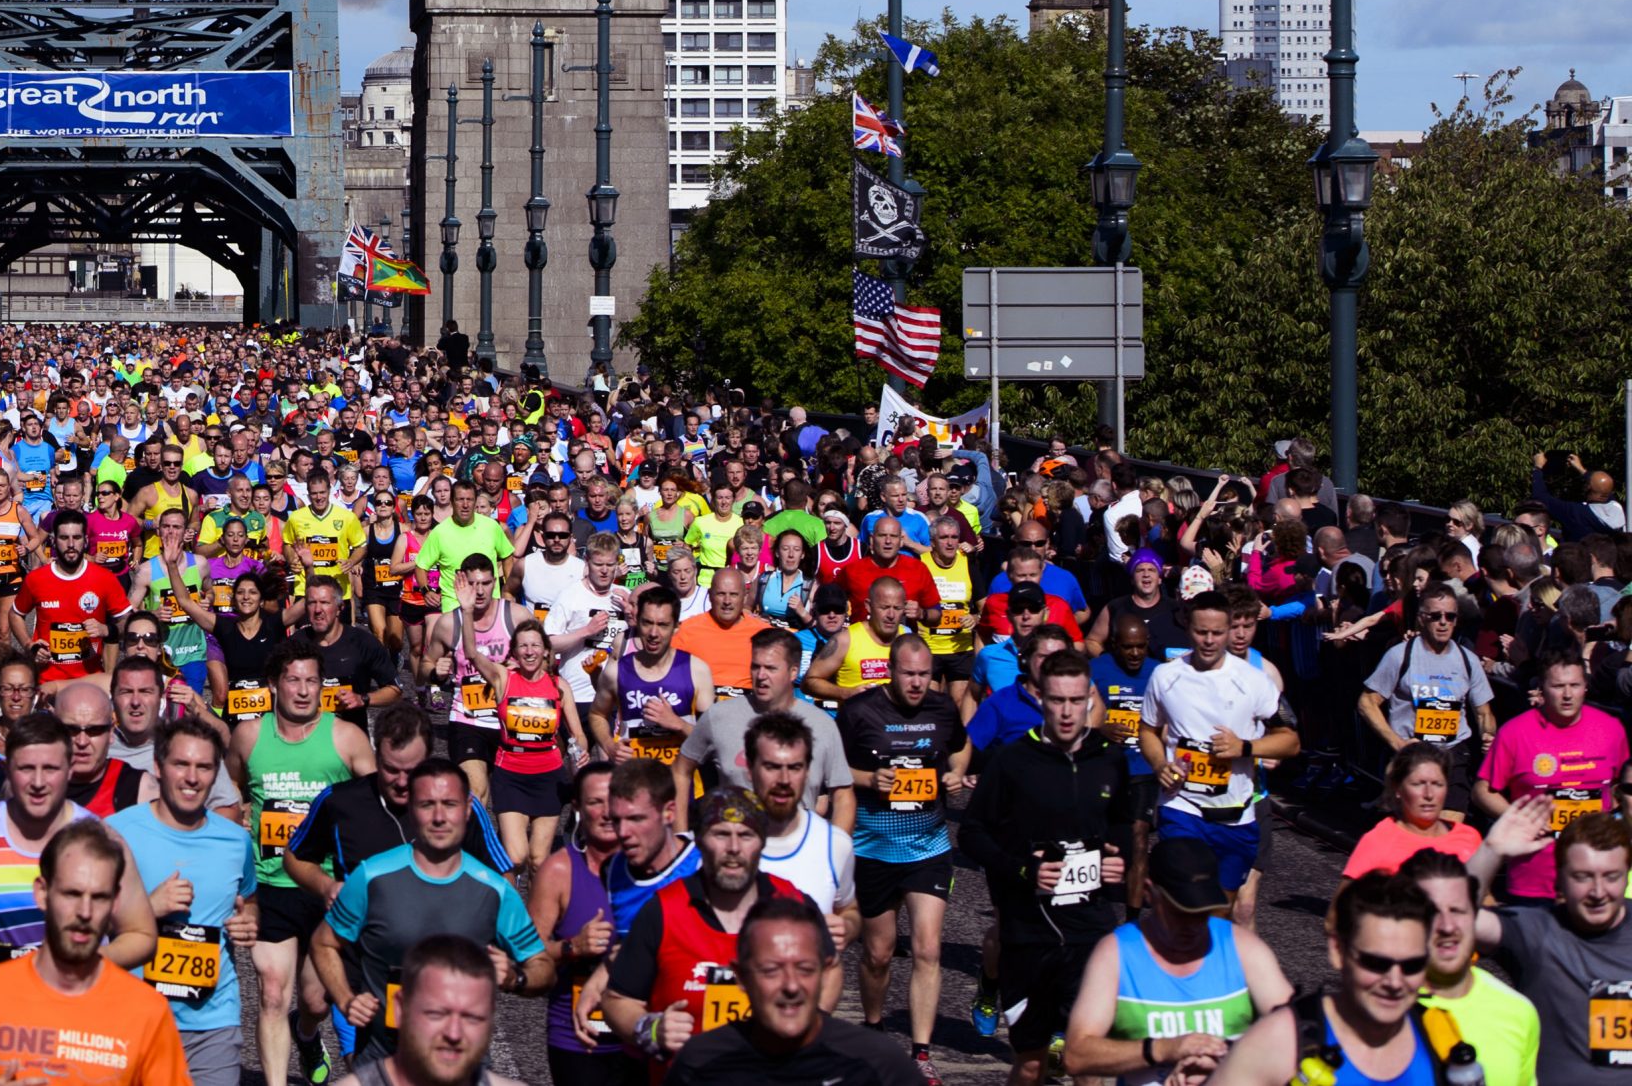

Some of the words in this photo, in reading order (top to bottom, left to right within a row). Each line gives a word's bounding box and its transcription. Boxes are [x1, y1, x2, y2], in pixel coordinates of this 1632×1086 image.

[114, 82, 207, 107] north
[158, 110, 220, 126] run
[6, 128, 31, 136] THE
[34, 127, 93, 136] WORLD'S
[96, 127, 167, 136] FAVOURITE
[169, 127, 196, 136] RUN
[373, 297, 393, 307] TIGERS
[313, 548, 337, 558] 4070
[41, 600, 60, 609] ADAM
[233, 697, 266, 710] 6589
[513, 714, 550, 729] 7663
[1418, 717, 1457, 731] 12875
[262, 773, 275, 782] WE
[276, 771, 300, 782] ARE
[894, 779, 934, 794] 2475
[1064, 864, 1098, 885] 460
[151, 952, 217, 979] 12788
[156, 982, 189, 997] PUMA
[1147, 1008, 1224, 1039] COLIN
[59, 1029, 113, 1051] MILLION
[57, 1045, 128, 1069] FINISHERS
